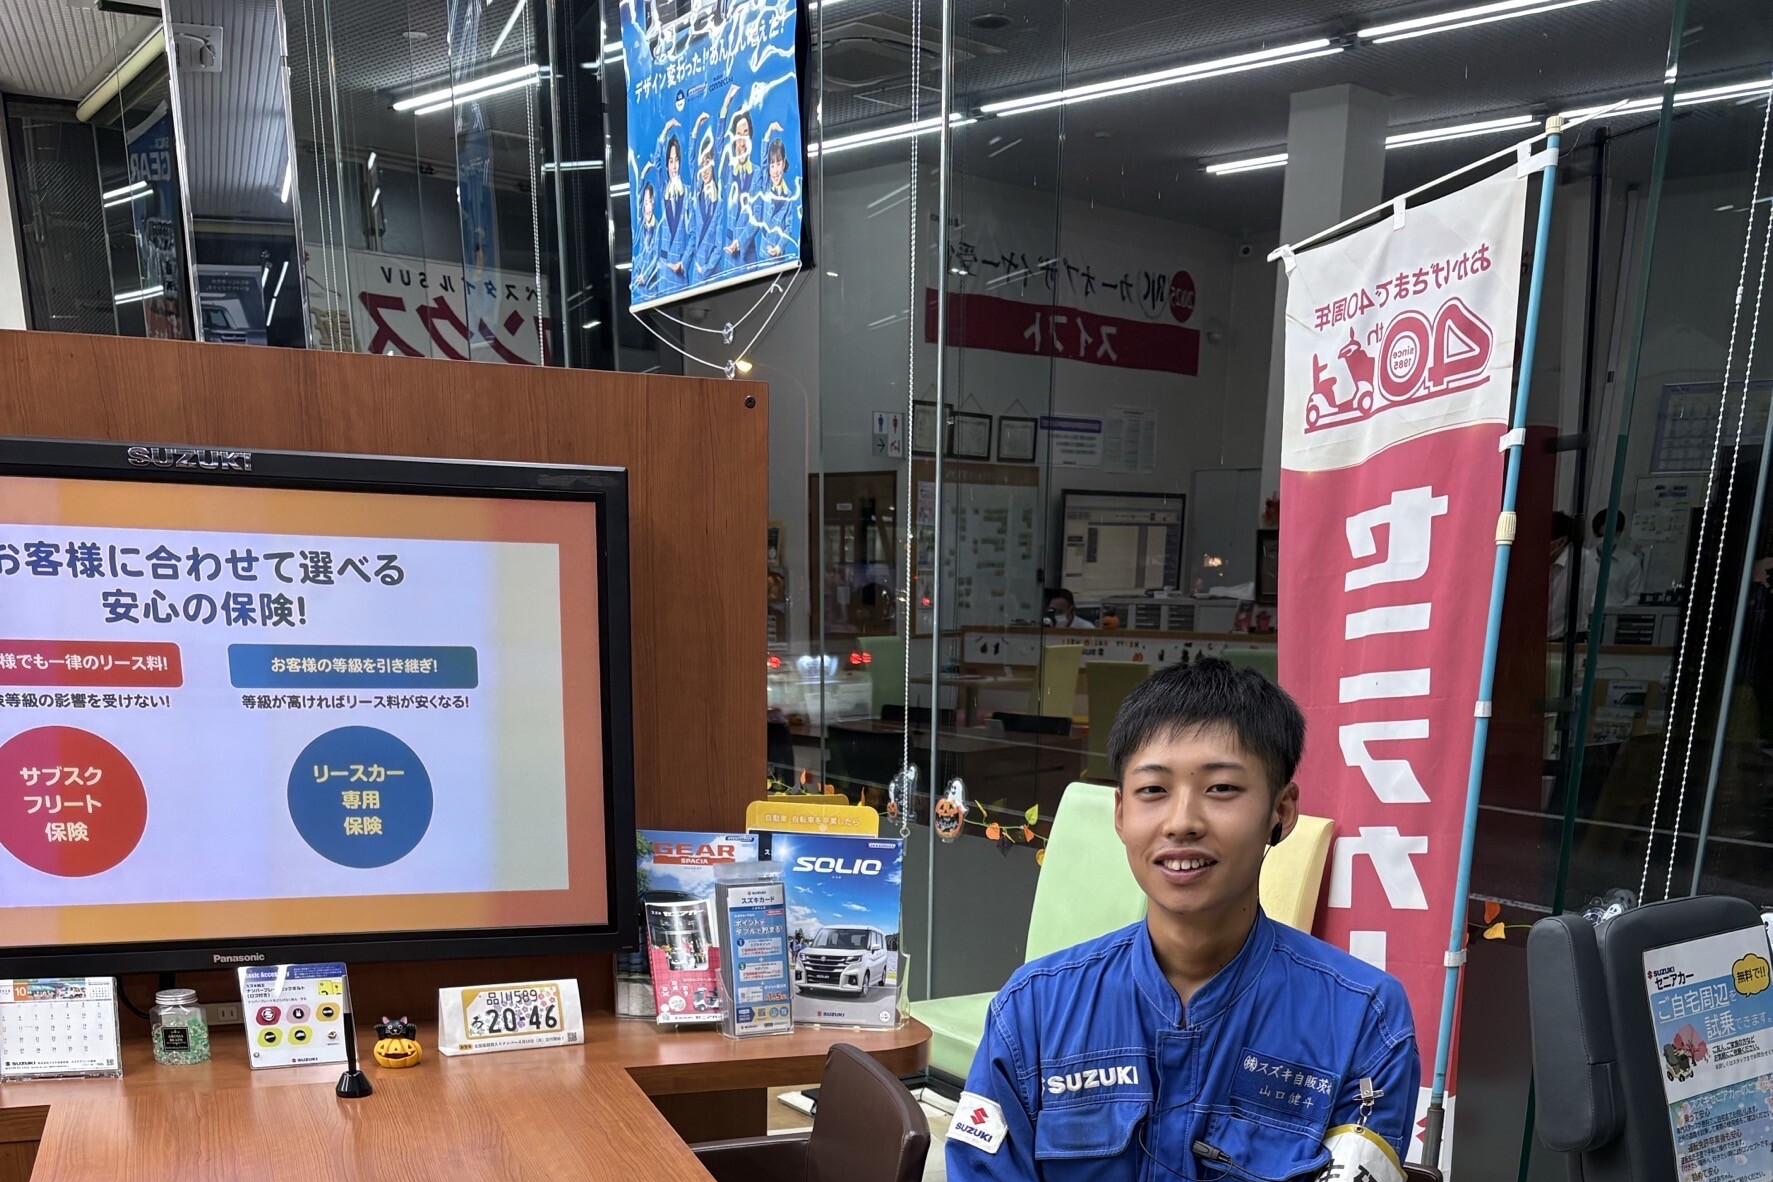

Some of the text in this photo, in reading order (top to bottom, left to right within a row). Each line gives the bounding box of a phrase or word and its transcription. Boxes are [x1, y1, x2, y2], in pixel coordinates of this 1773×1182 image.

[127, 446, 252, 472] SUZUKI
[102, 588, 307, 628] 安心の保険!
[271, 656, 438, 675] お客様の等級を引き継ぎ!
[241, 694, 469, 710] 等級が高ければリース料が安くなる!
[19, 766, 103, 786] サブスク
[312, 765, 405, 784] リースカー
[23, 795, 102, 814] フリート
[341, 791, 381, 810] 専用
[44, 822, 89, 842] 保険
[343, 816, 383, 836] 保険
[653, 842, 735, 857] GEAR
[793, 856, 883, 875] SOLIO
[741, 896, 775, 904] スズキカード
[213, 952, 266, 963] Panasonic
[1653, 966, 1675, 977] SUZUKI
[1655, 971, 1694, 990] セニアカー
[1737, 966, 1766, 984] 無料で!!
[14, 986, 26, 997] 10
[486, 989, 538, 1006] 品川 589
[1658, 983, 1738, 1020] ご自宅周辺を
[486, 1005, 558, 1034] 20-46
[1704, 1010, 1773, 1039] 試乗できます。
[1048, 1067, 1139, 1094] SUZUKI
[1259, 1085, 1314, 1108] 山口健斗
[955, 1122, 993, 1143] SUZUKI
